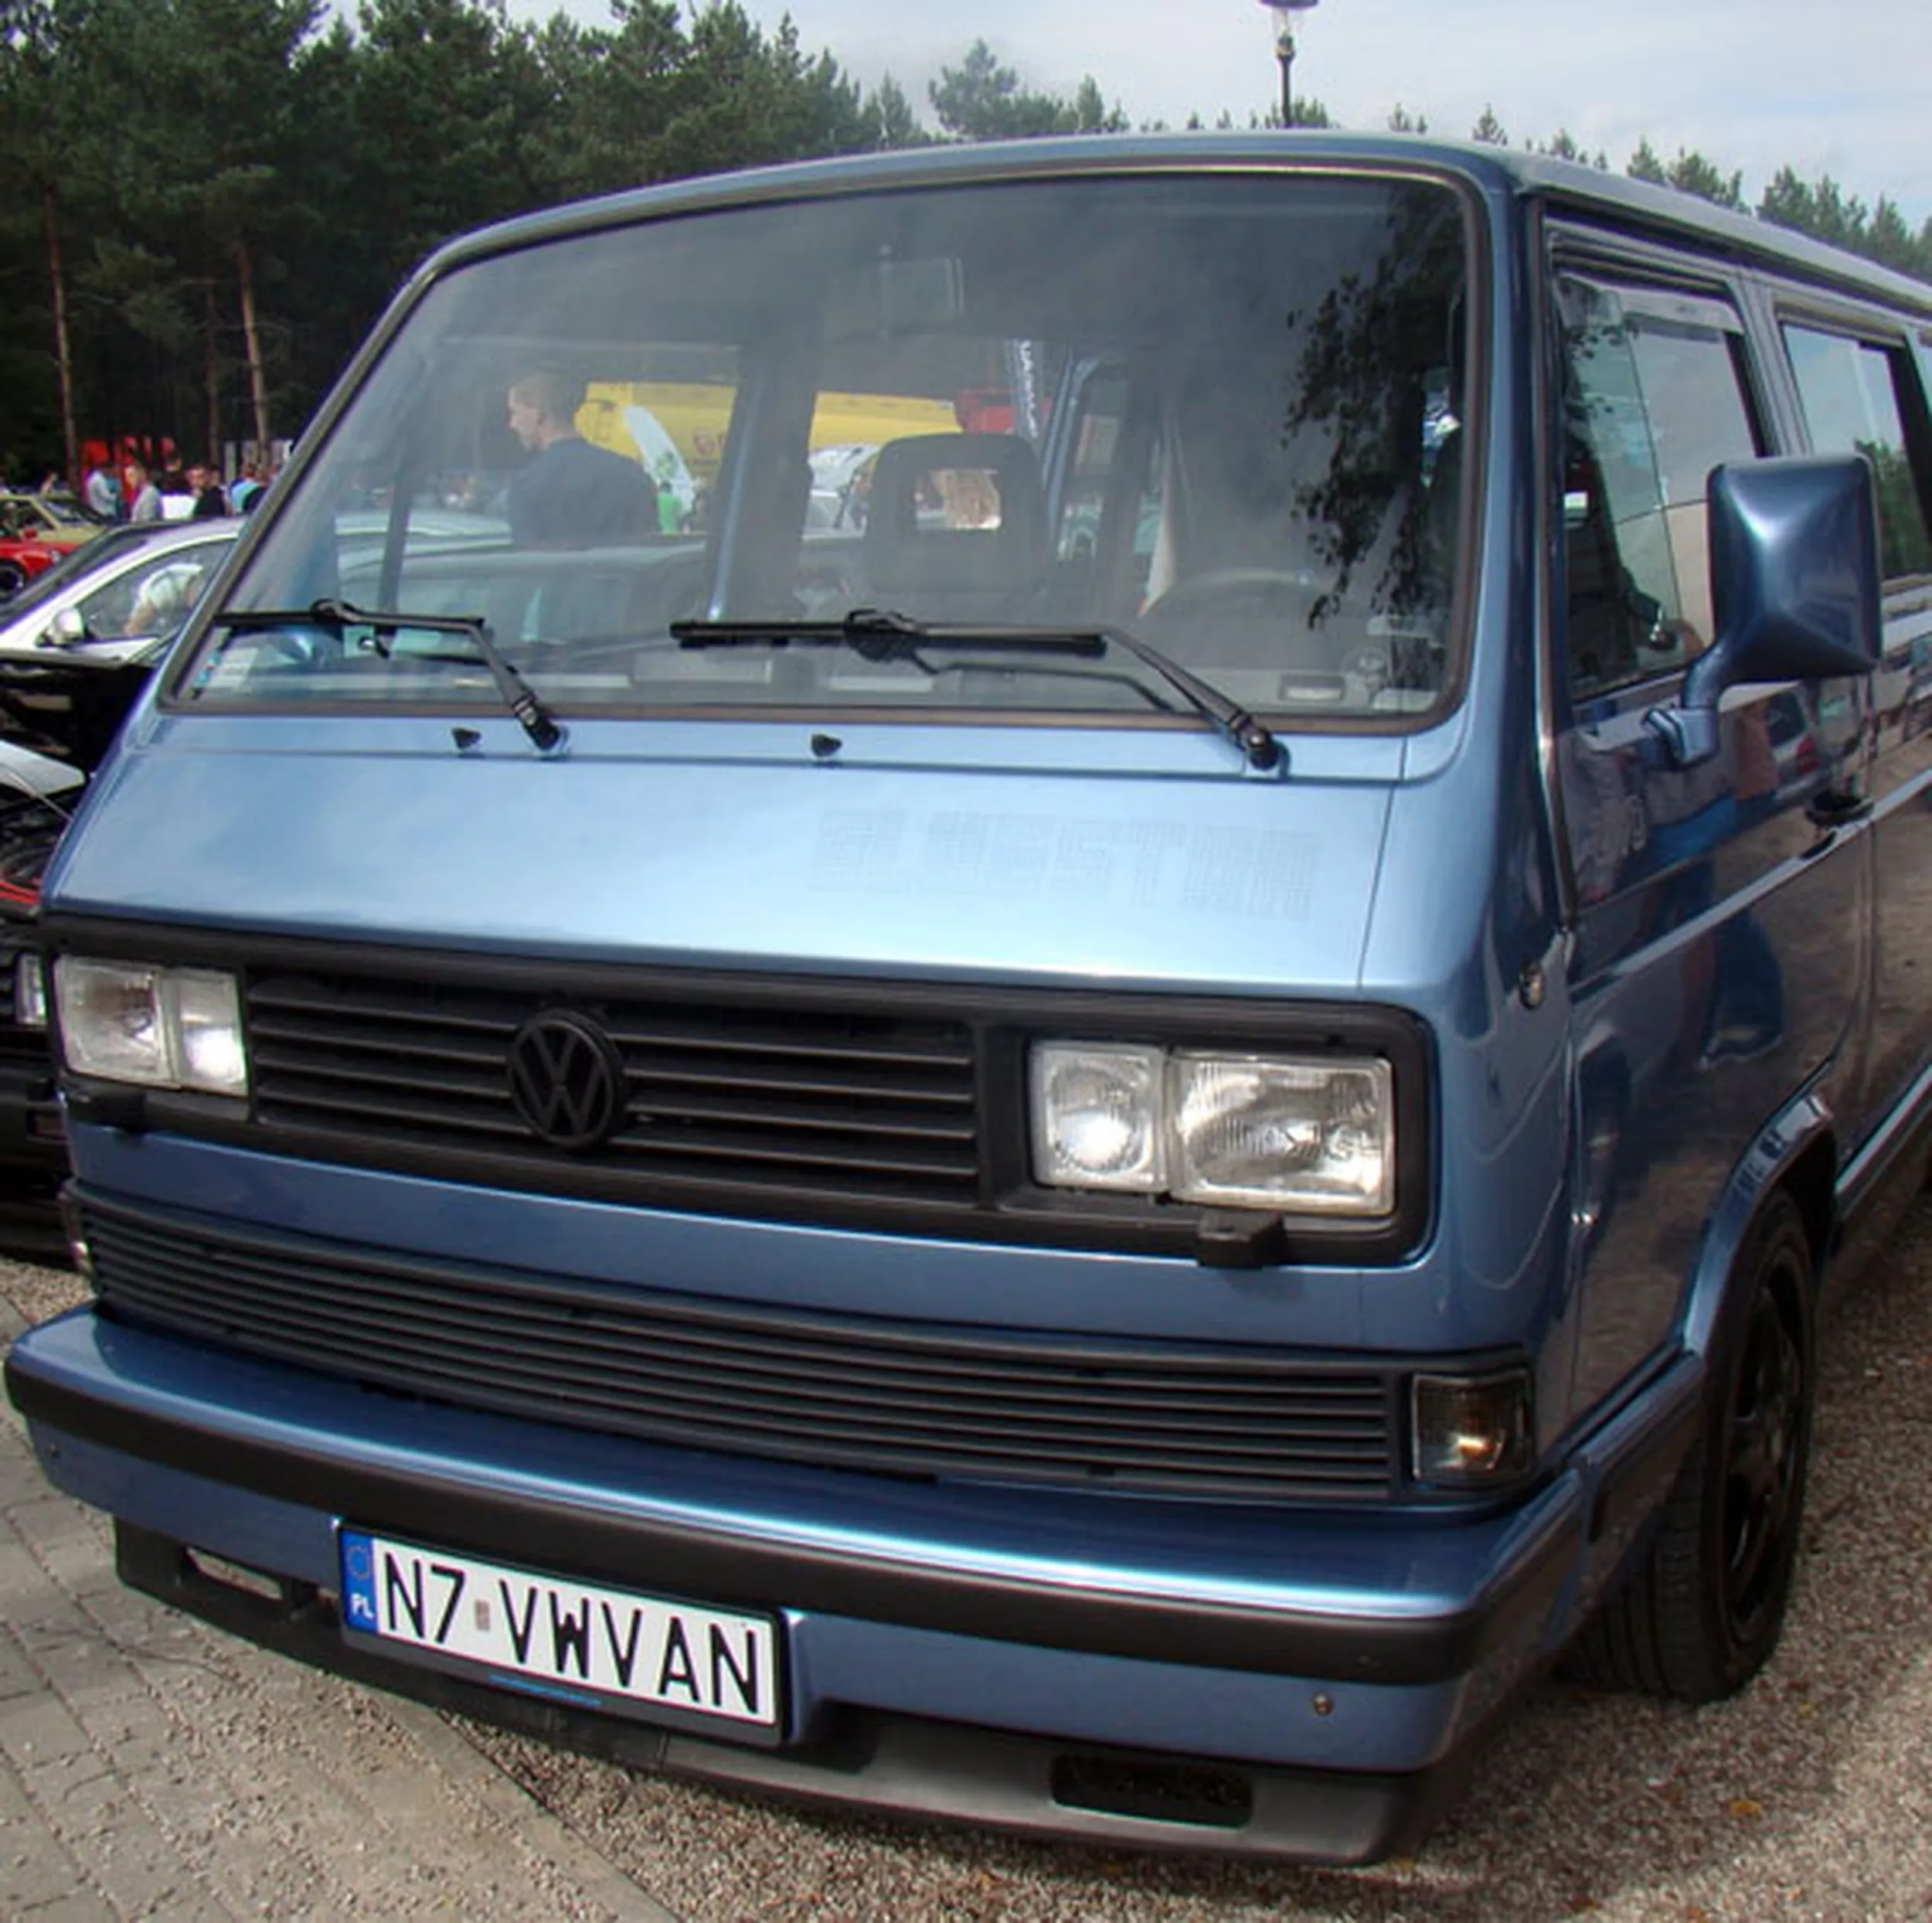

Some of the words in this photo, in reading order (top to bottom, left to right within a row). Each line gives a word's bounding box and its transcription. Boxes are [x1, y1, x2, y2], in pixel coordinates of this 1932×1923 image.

[351, 1593, 375, 1619] PL
[385, 1552, 465, 1643] N7
[499, 1579, 758, 1714] VWVAN
